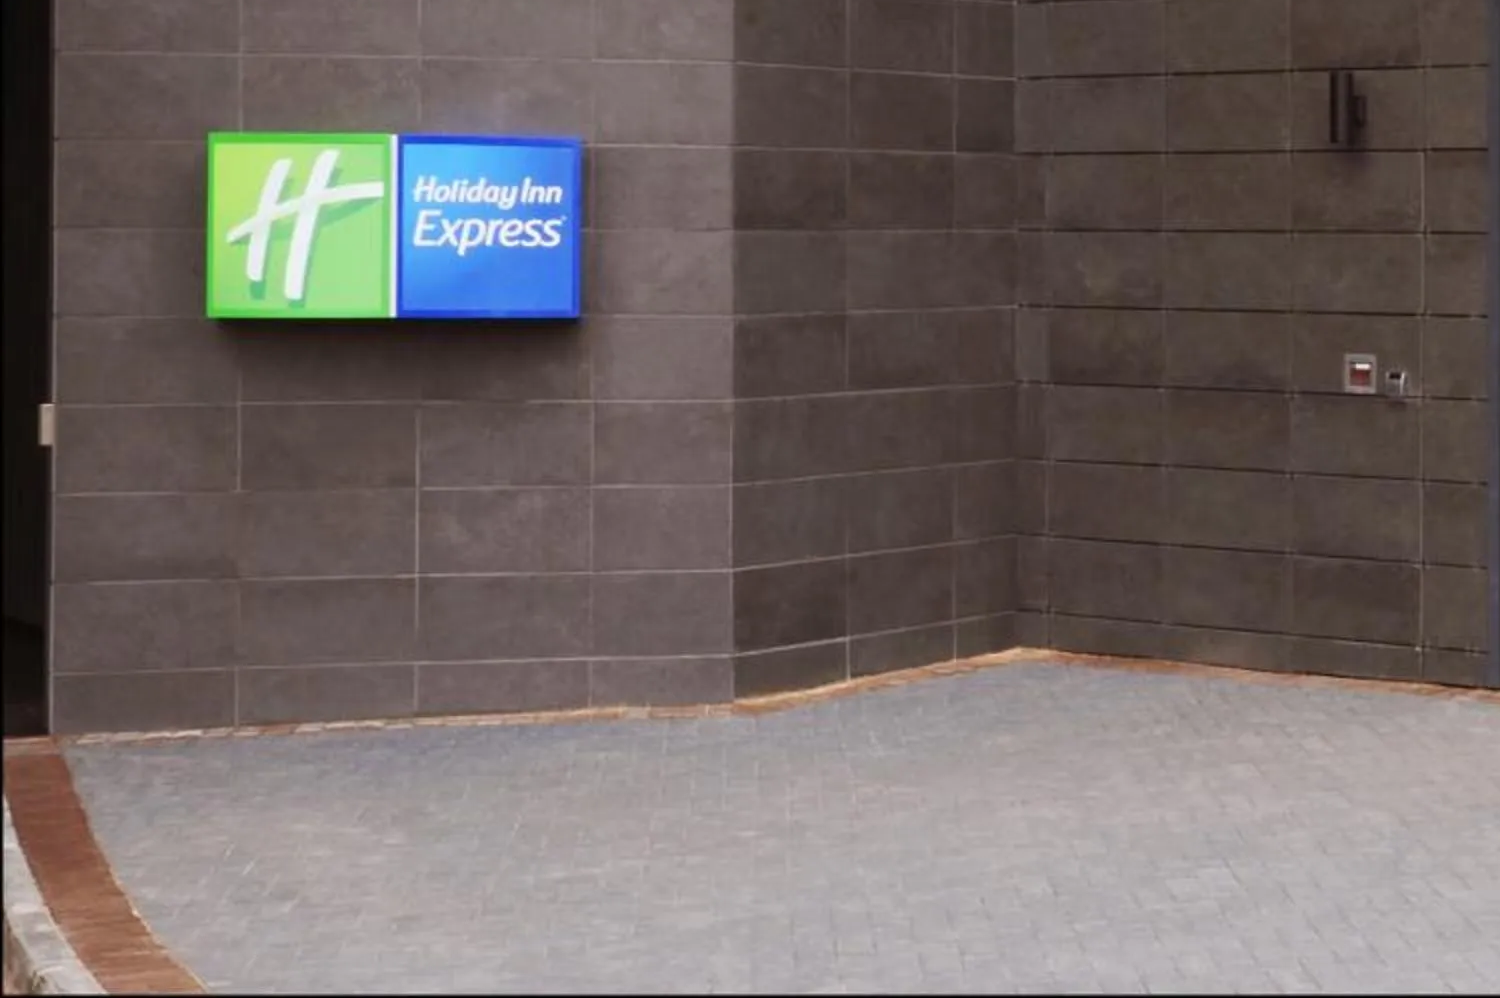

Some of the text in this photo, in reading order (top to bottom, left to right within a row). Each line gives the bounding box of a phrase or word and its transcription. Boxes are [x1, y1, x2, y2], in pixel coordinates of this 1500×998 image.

[413, 175, 563, 210] Holiday Inn
[413, 209, 564, 256] Express
